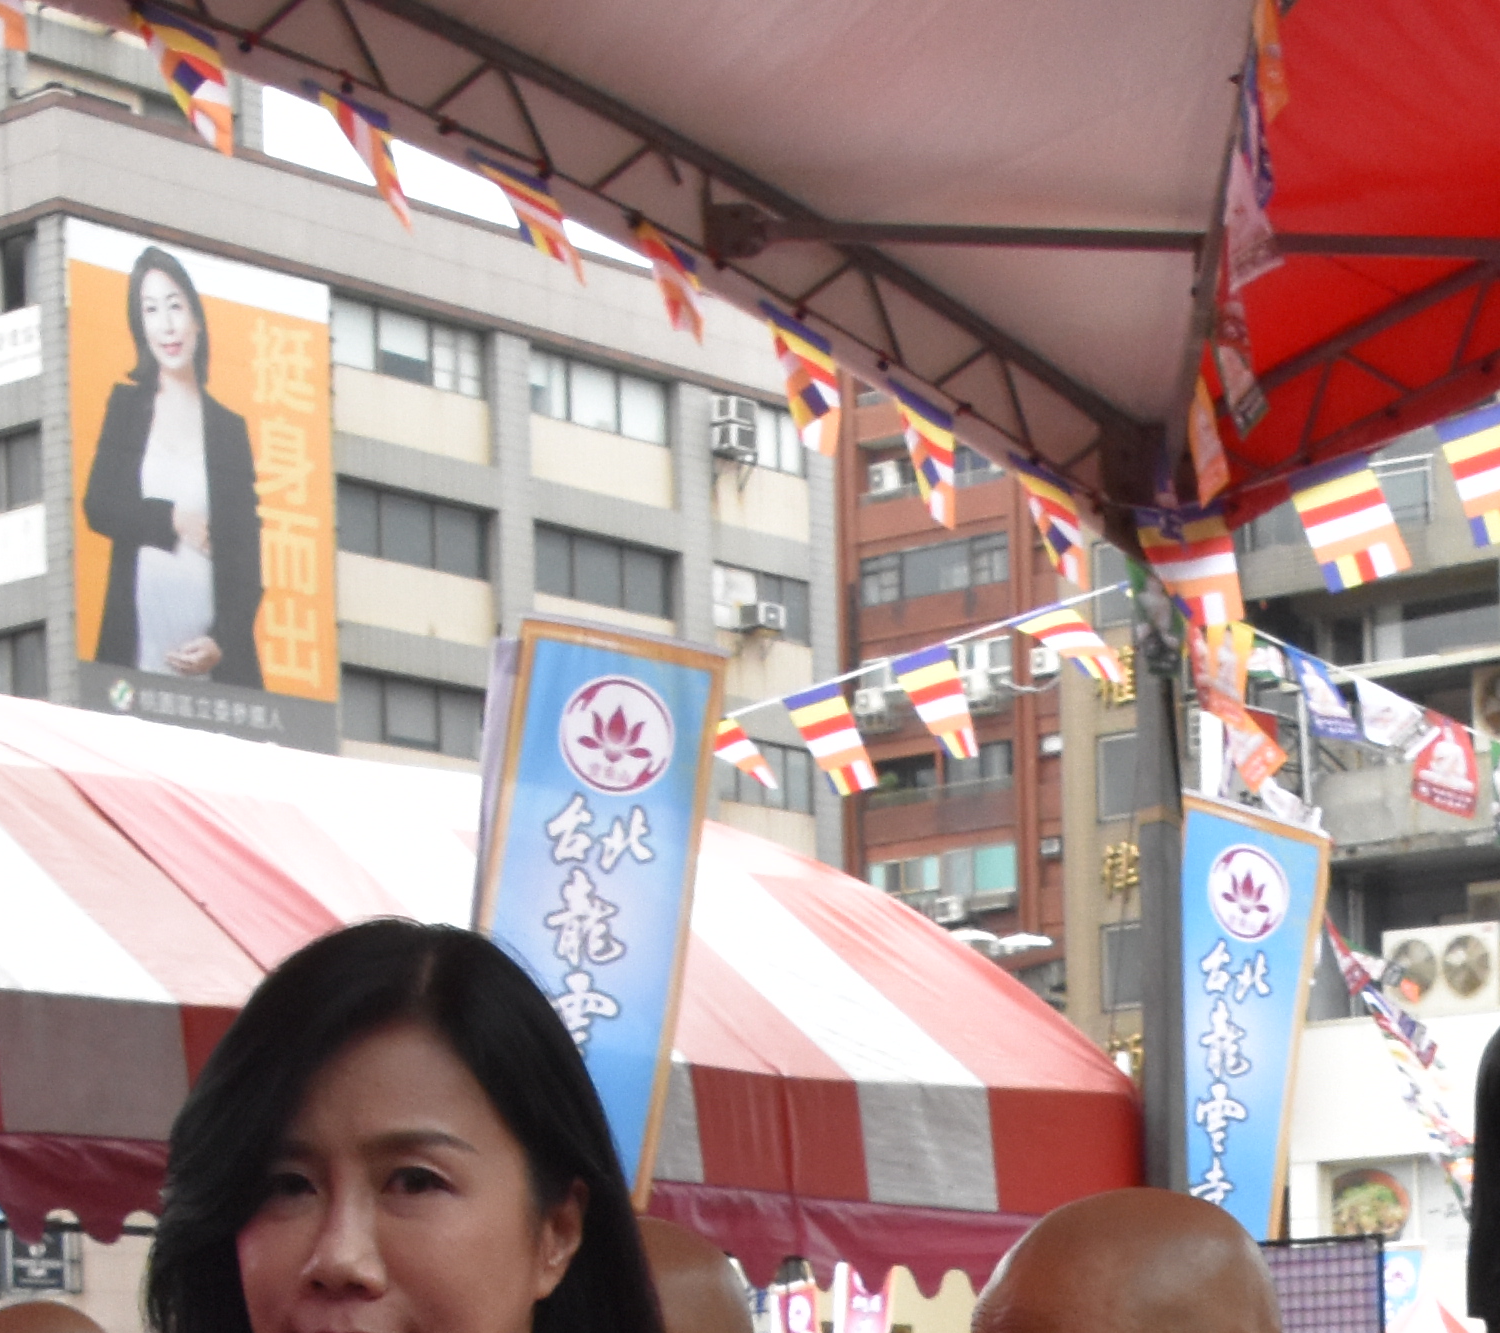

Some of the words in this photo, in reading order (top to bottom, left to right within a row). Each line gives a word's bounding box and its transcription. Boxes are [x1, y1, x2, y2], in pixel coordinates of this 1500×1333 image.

[252, 315, 322, 690] 挺身而出
[545, 793, 655, 872] 台北
[1199, 938, 1271, 1001] 台北
